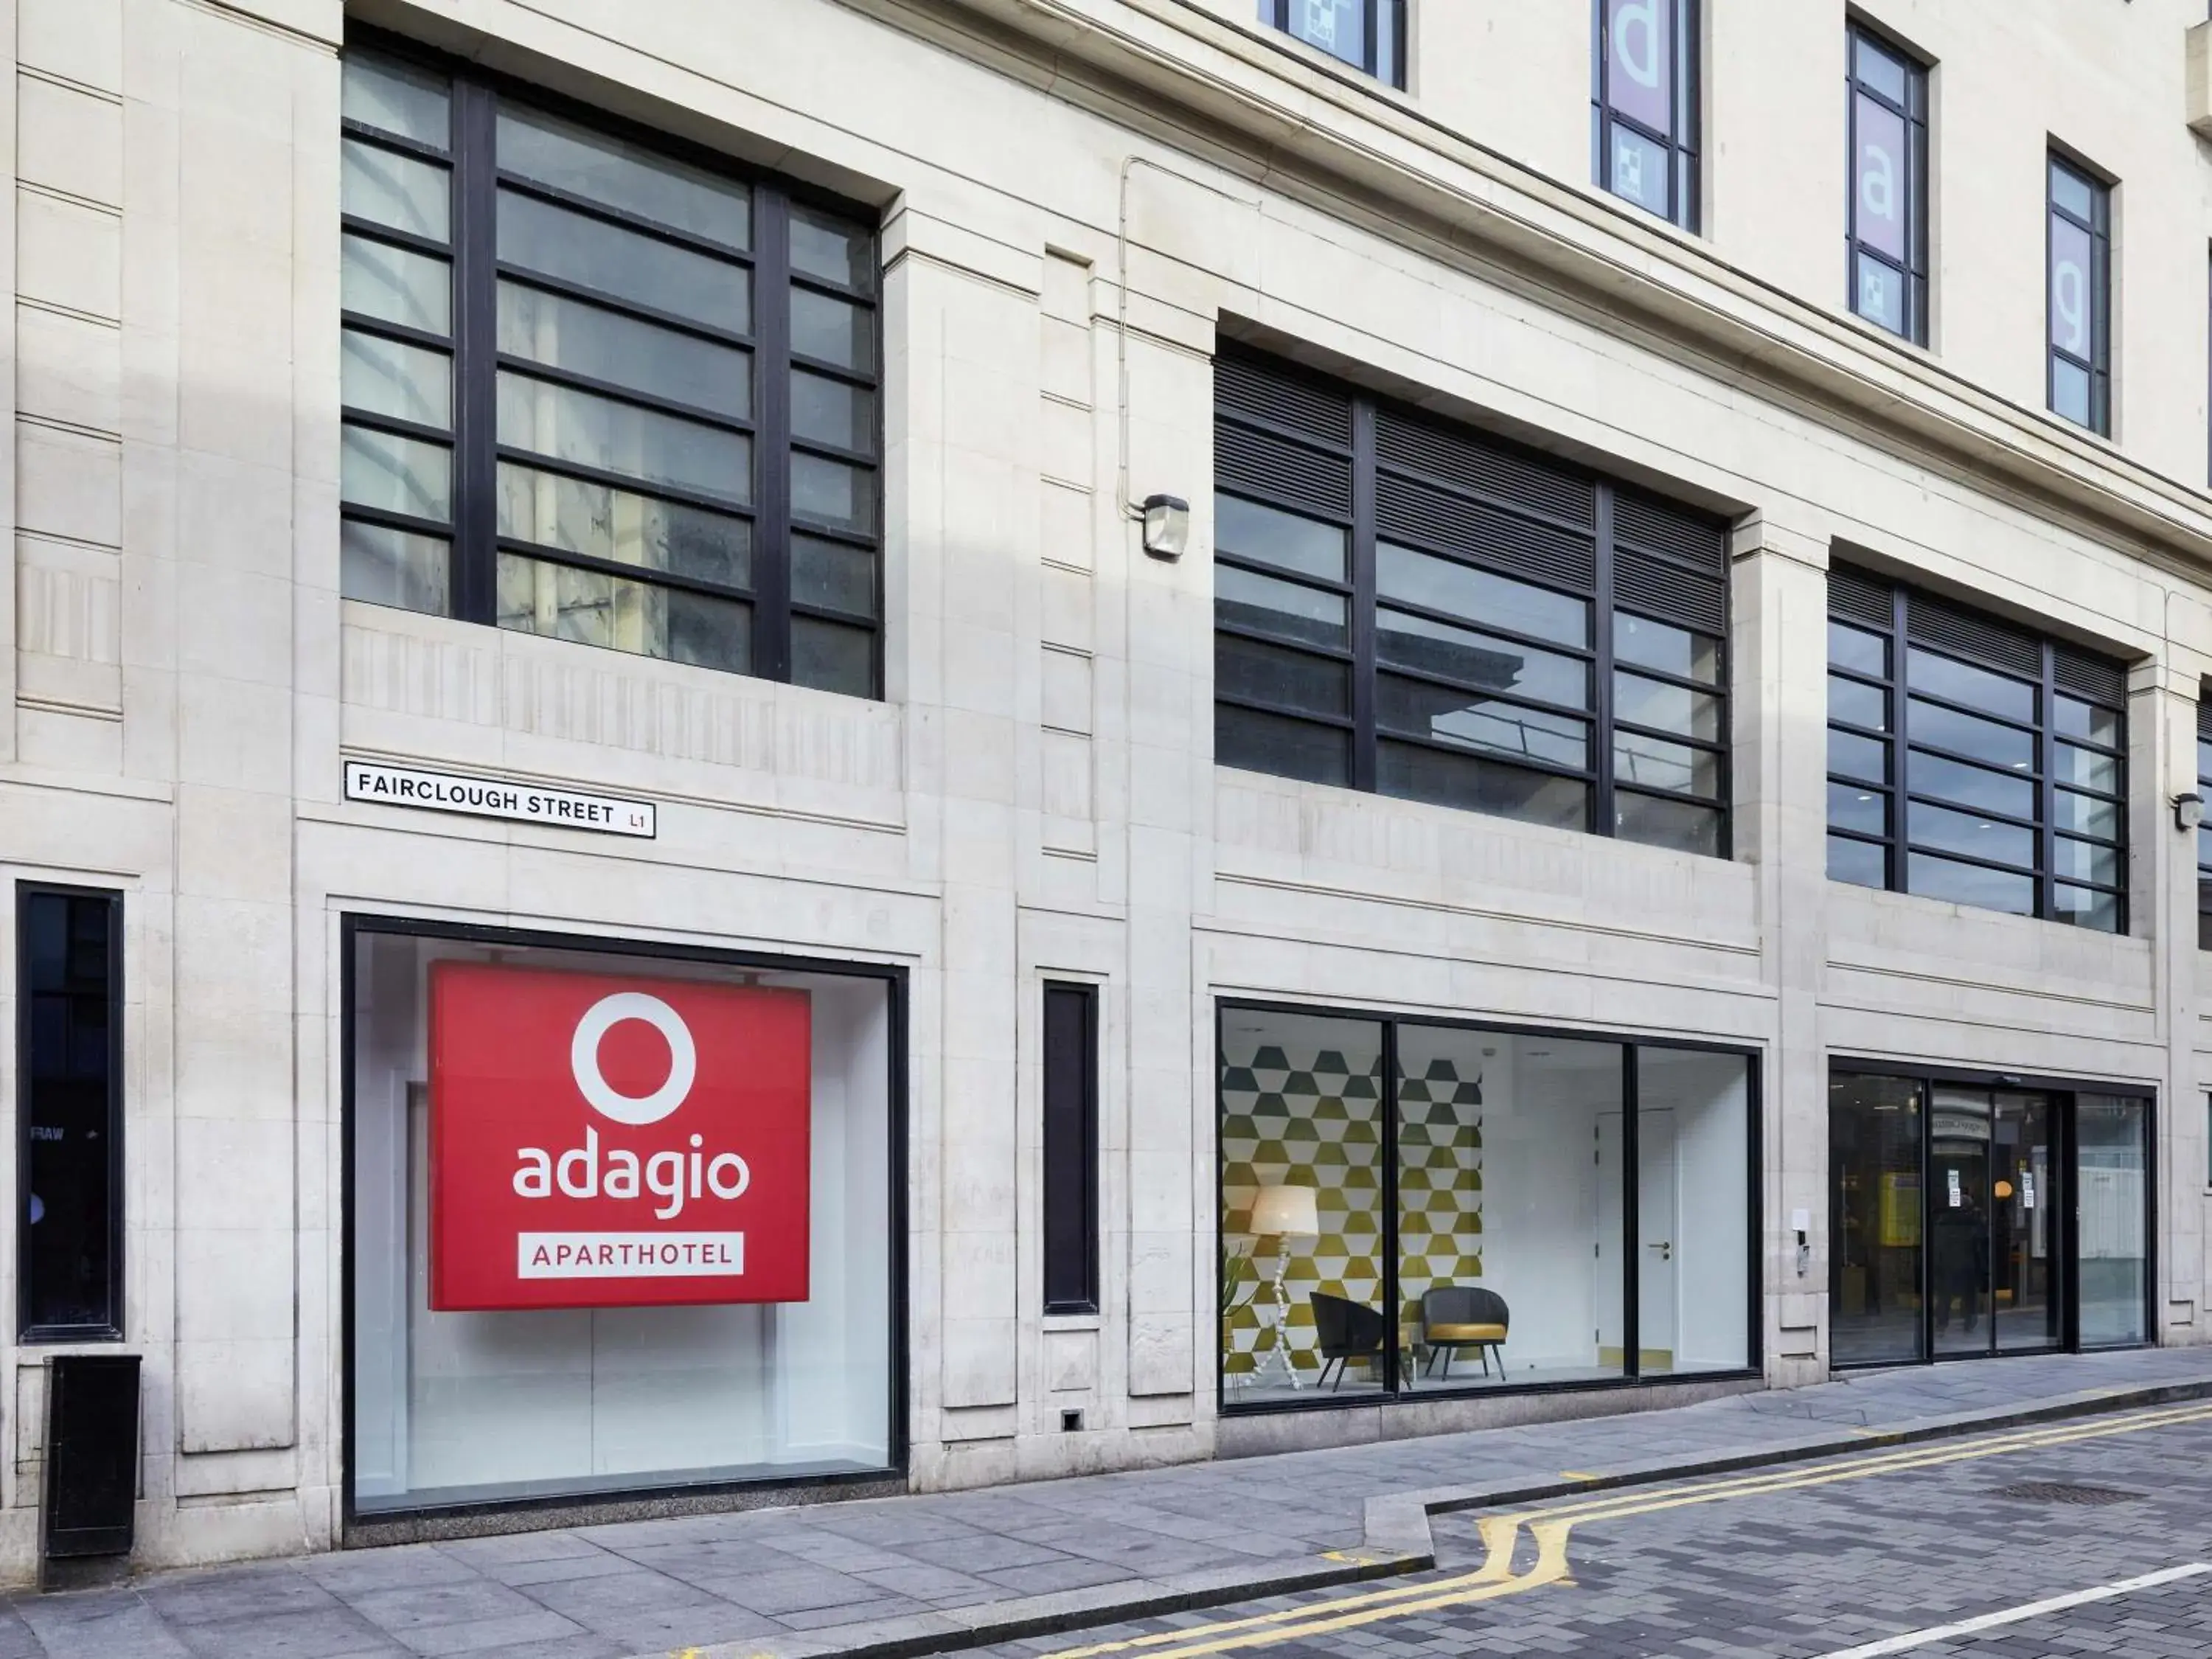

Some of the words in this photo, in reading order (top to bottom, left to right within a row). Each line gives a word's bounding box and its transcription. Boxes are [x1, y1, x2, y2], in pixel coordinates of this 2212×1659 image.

[1863, 145, 1893, 221] a
[2055, 260, 2082, 352] g
[358, 773, 518, 810] FAIRCLOUGH
[527, 796, 613, 823] STREET
[630, 814, 644, 827] L1
[512, 1124, 750, 1220] adagio
[532, 1244, 732, 1266] APARTHOTEL
